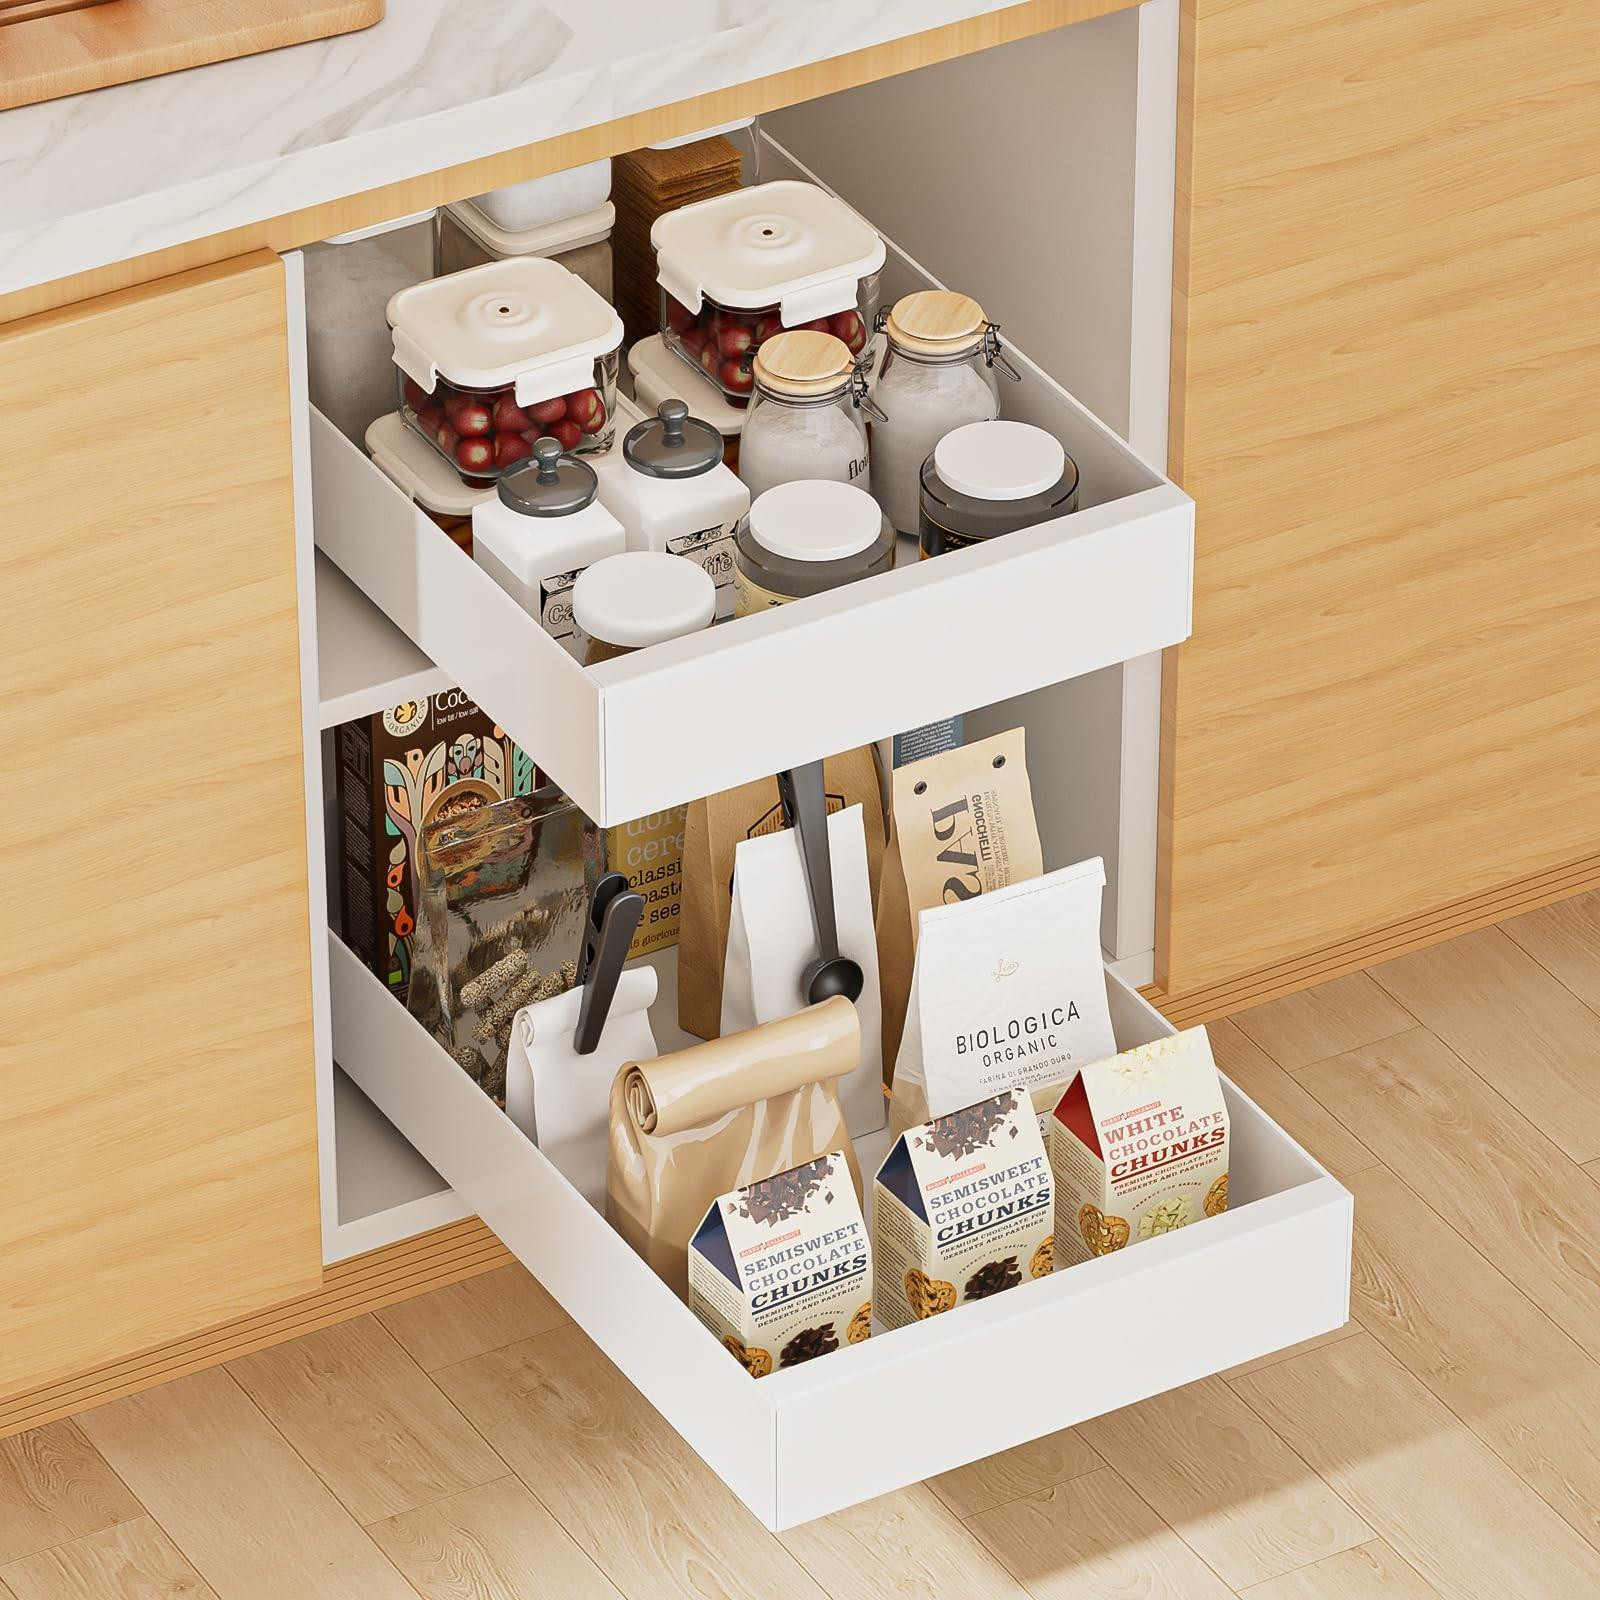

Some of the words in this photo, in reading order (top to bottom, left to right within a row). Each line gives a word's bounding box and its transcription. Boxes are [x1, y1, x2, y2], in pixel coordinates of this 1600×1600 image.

[956, 1001, 1080, 1054] BIOLOGICA
[982, 1034, 1057, 1067] ORGANIC
[1104, 1106, 1184, 1144] WHITE
[1109, 1111, 1223, 1160] CHOCOLATE
[1111, 1127, 1225, 1177] CHUNKS
[1114, 1174, 1153, 1191] PREMIUM
[1155, 1156, 1204, 1176] CHOCOLATE
[1205, 1149, 1222, 1158] FOR
[930, 1157, 1042, 1210] SEMISWEET
[935, 1172, 1049, 1224] CHOCOLATE
[1117, 1179, 1158, 1197] DESSERTS
[1160, 1171, 1178, 1182] AND
[1180, 1157, 1219, 1175] PASTRIES
[937, 1188, 1050, 1241] CHUNKS
[940, 1237, 979, 1255] PREMIUM
[981, 1219, 1029, 1239] CHOCOLATE
[1031, 1210, 1047, 1219] FOR
[744, 1222, 859, 1276] SEMISWEET
[943, 1242, 983, 1261] DESSERTS
[986, 1234, 1004, 1244] AND
[1005, 1218, 1044, 1237] PASTRIES
[749, 1238, 865, 1292] CHOCOLATE
[752, 1254, 867, 1309] CHUNKS
[755, 1303, 794, 1322] PREMIUM
[796, 1284, 845, 1307] CHOCOLATE
[847, 1275, 864, 1286] FOR
[758, 1309, 799, 1328] DESSERTS
[801, 1300, 820, 1311] AND
[821, 1284, 861, 1303] PASTRIES
